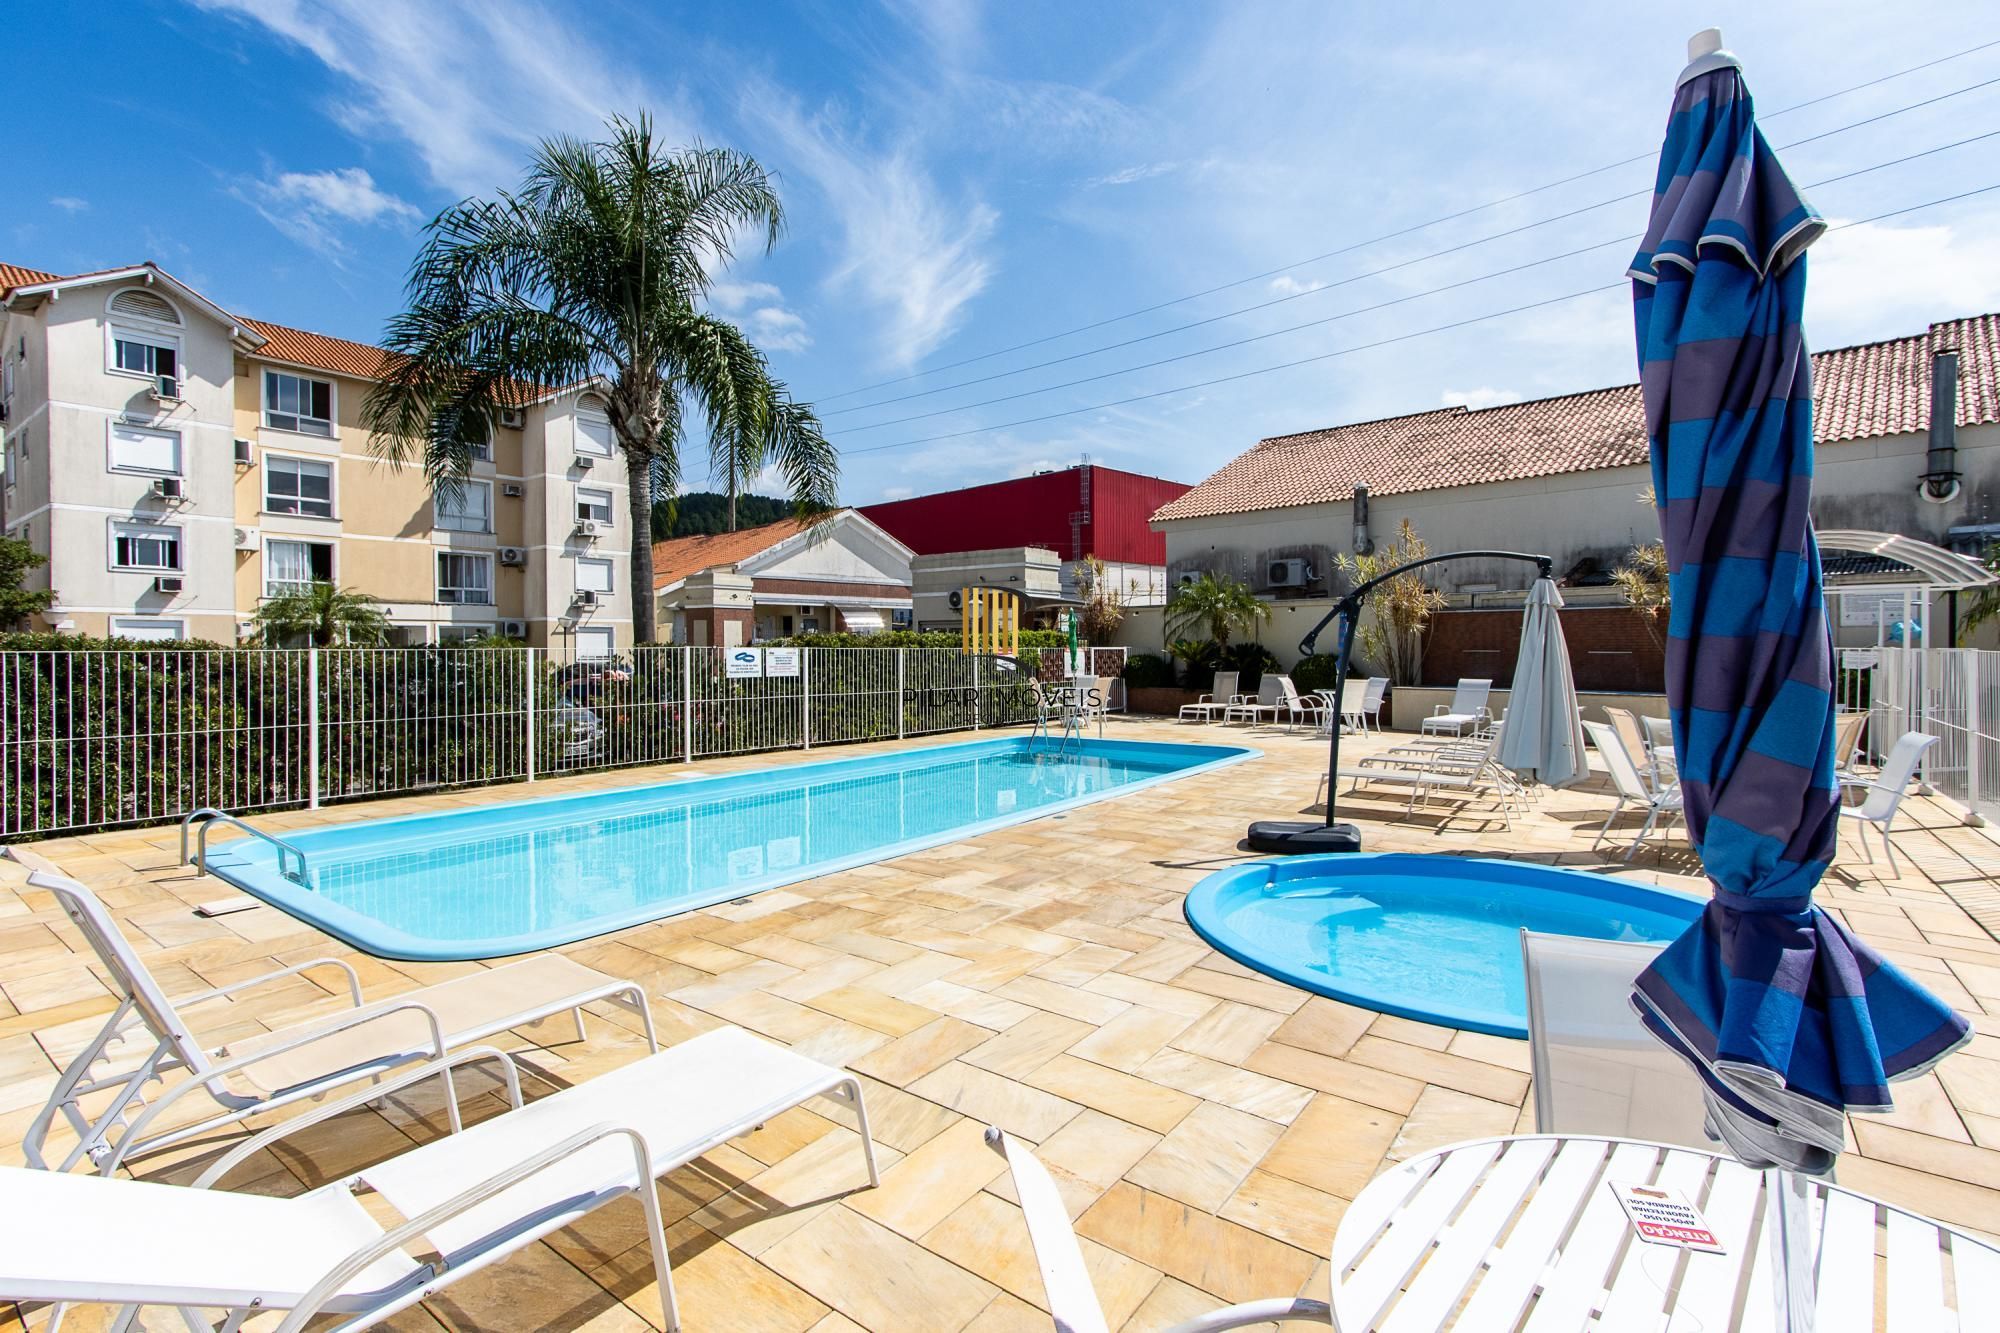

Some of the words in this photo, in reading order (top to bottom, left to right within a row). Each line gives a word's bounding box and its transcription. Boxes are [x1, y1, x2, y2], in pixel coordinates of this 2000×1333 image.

[1646, 1201, 1682, 1210] GUARDA
[1632, 1206, 1665, 1215] FECHAR
[1667, 1210, 1695, 1219] FAVOR
[1642, 1225, 1711, 1241] ATENÇÃO
